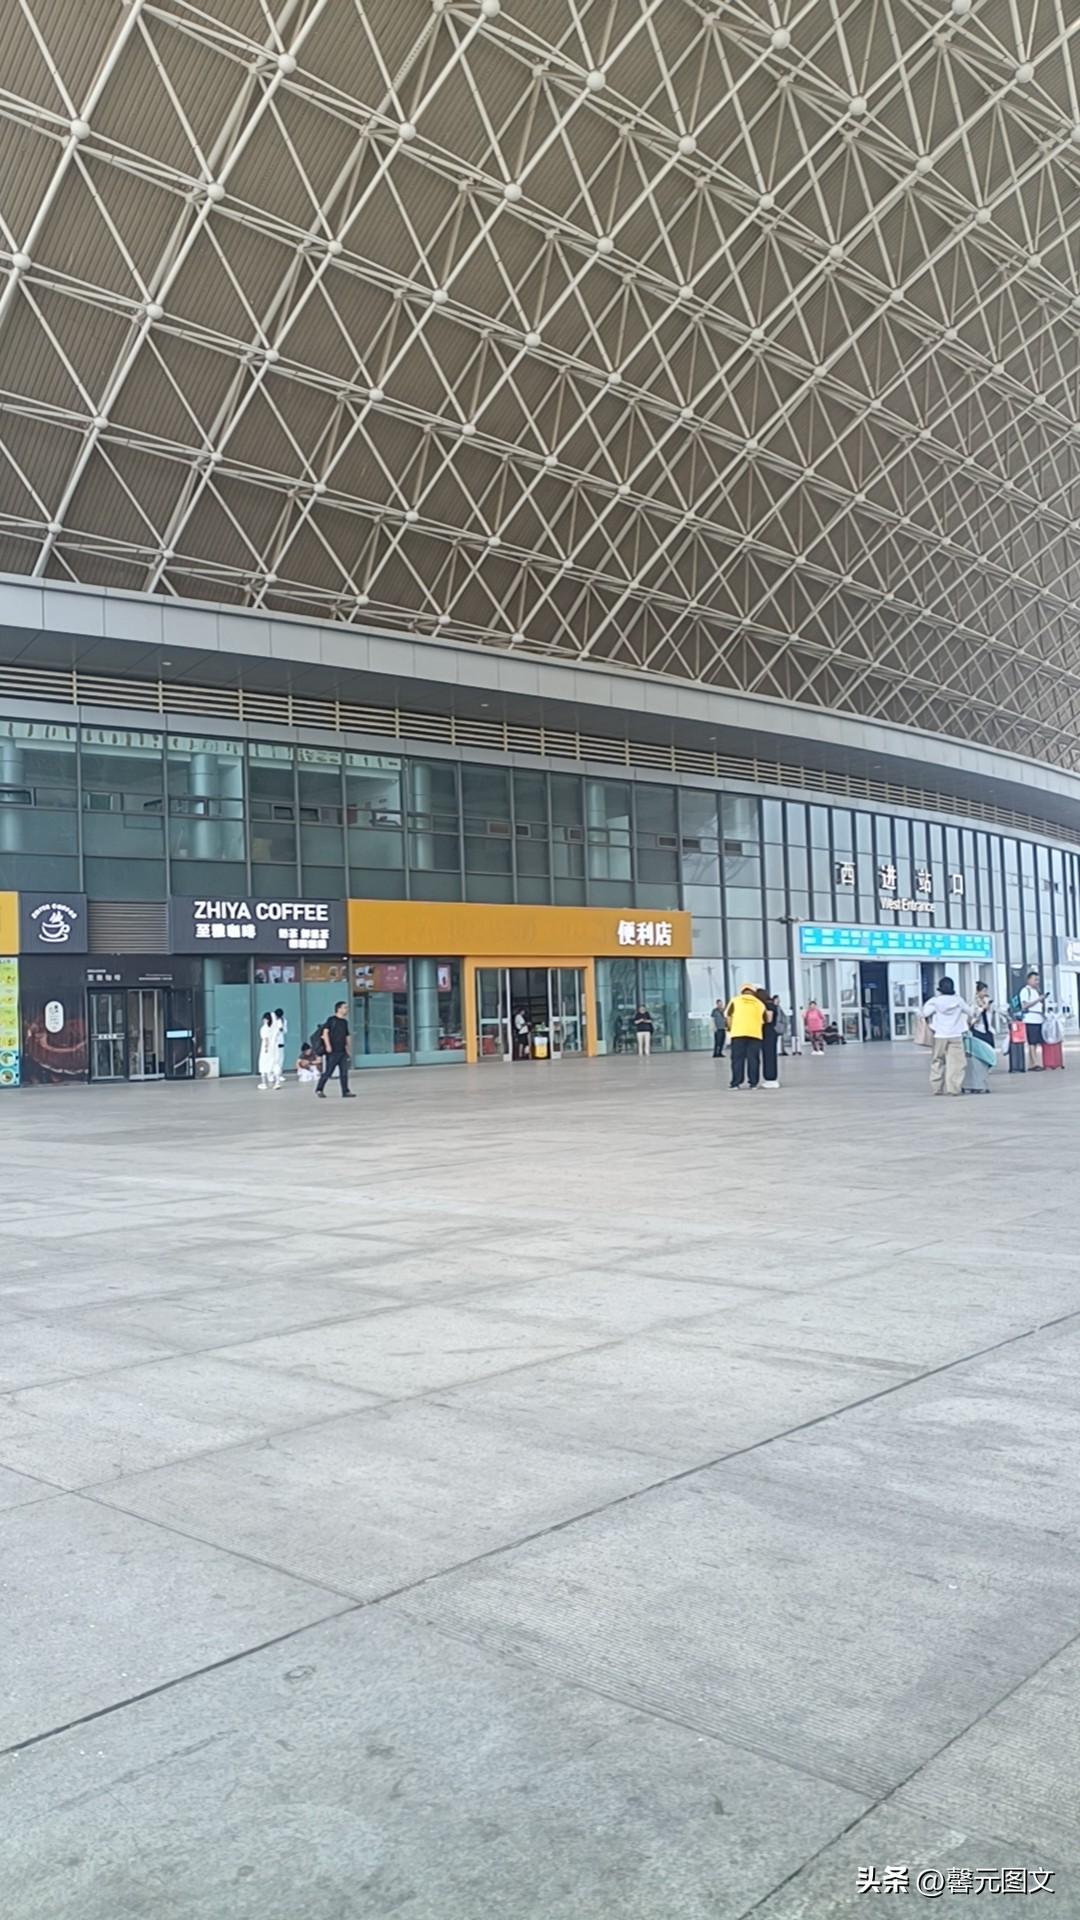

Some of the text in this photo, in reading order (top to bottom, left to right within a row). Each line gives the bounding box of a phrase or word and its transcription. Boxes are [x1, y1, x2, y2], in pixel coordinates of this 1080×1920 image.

[834, 861, 963, 895] 西进站口
[194, 901, 328, 921] ZHIYA COFFEE
[880, 896, 935, 912] West Entrance
[617, 919, 672, 946] 便利店
